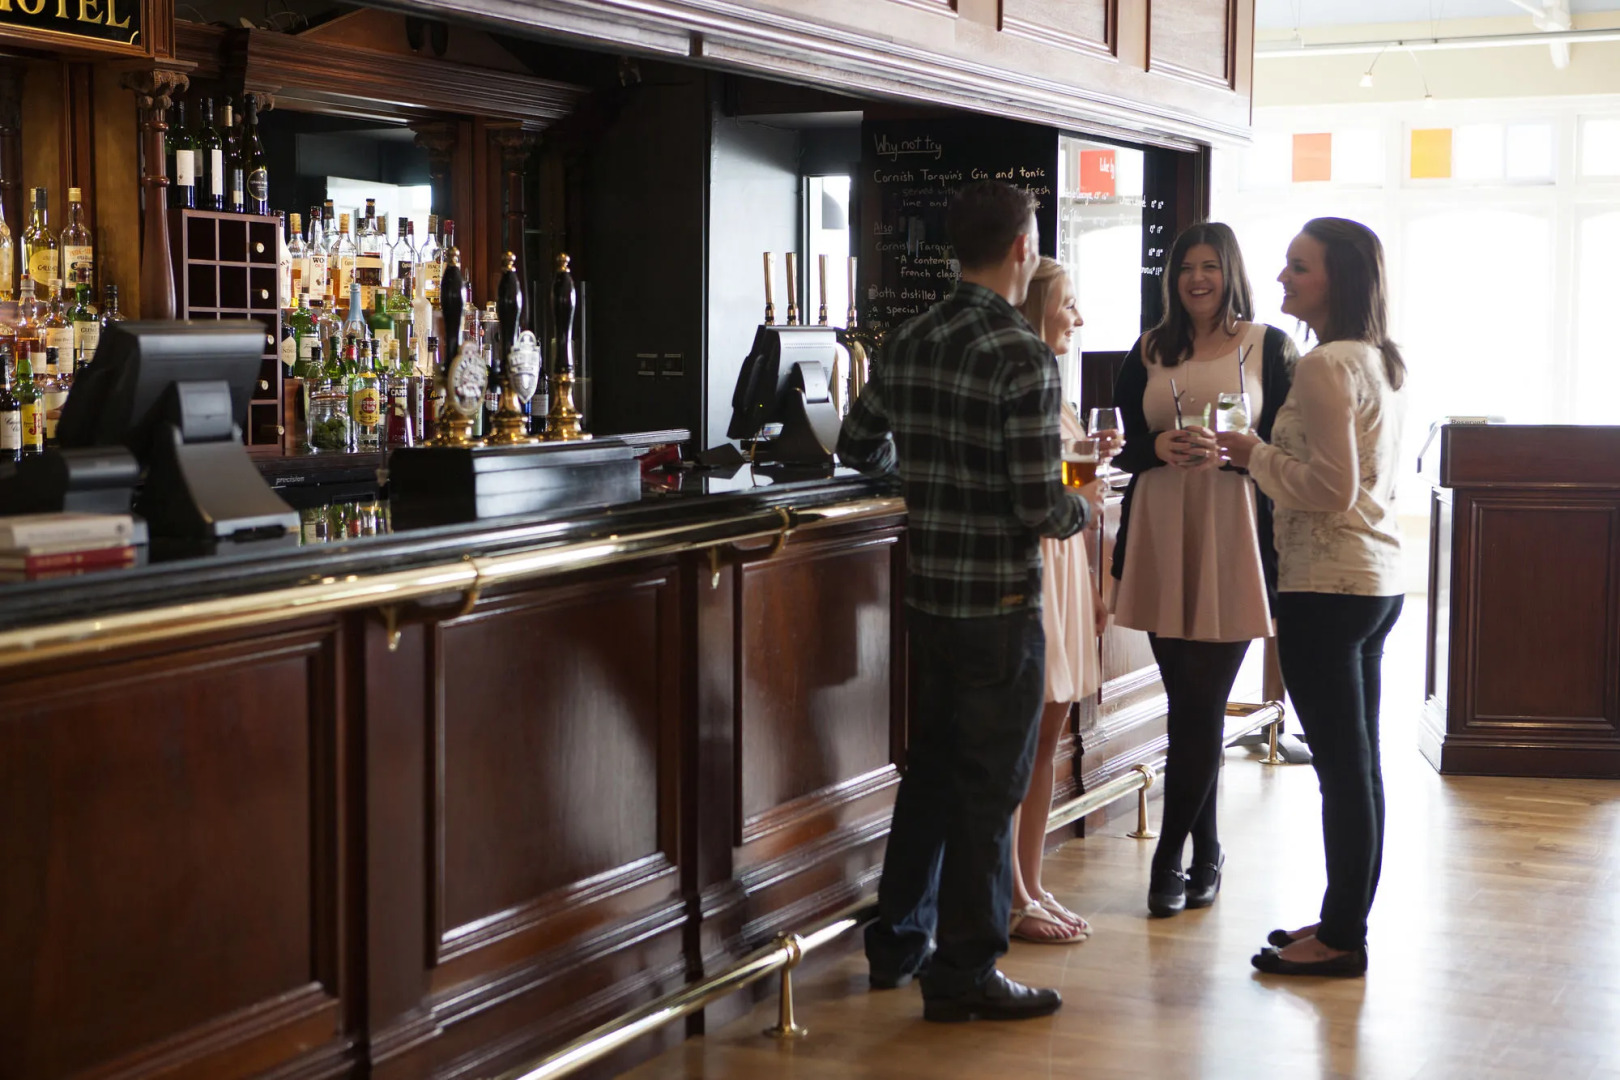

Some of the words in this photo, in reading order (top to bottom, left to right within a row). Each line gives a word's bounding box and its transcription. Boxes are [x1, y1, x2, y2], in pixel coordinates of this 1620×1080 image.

[0, 0, 132, 28] TEL
[874, 133, 898, 162] Why
[901, 136, 922, 150] not
[923, 134, 942, 160] try
[873, 169, 914, 183] Cornish
[971, 168, 989, 180] Gin
[995, 167, 1014, 179] and
[1019, 166, 1046, 179] tonic
[902, 187, 934, 197] served
[1025, 183, 1051, 196] fresh
[903, 199, 922, 207] lime
[929, 198, 948, 207] and
[873, 222, 893, 233] Also
[900, 287, 937, 300] distilled
[886, 305, 919, 317] special
[275, 476, 305, 486] precision
